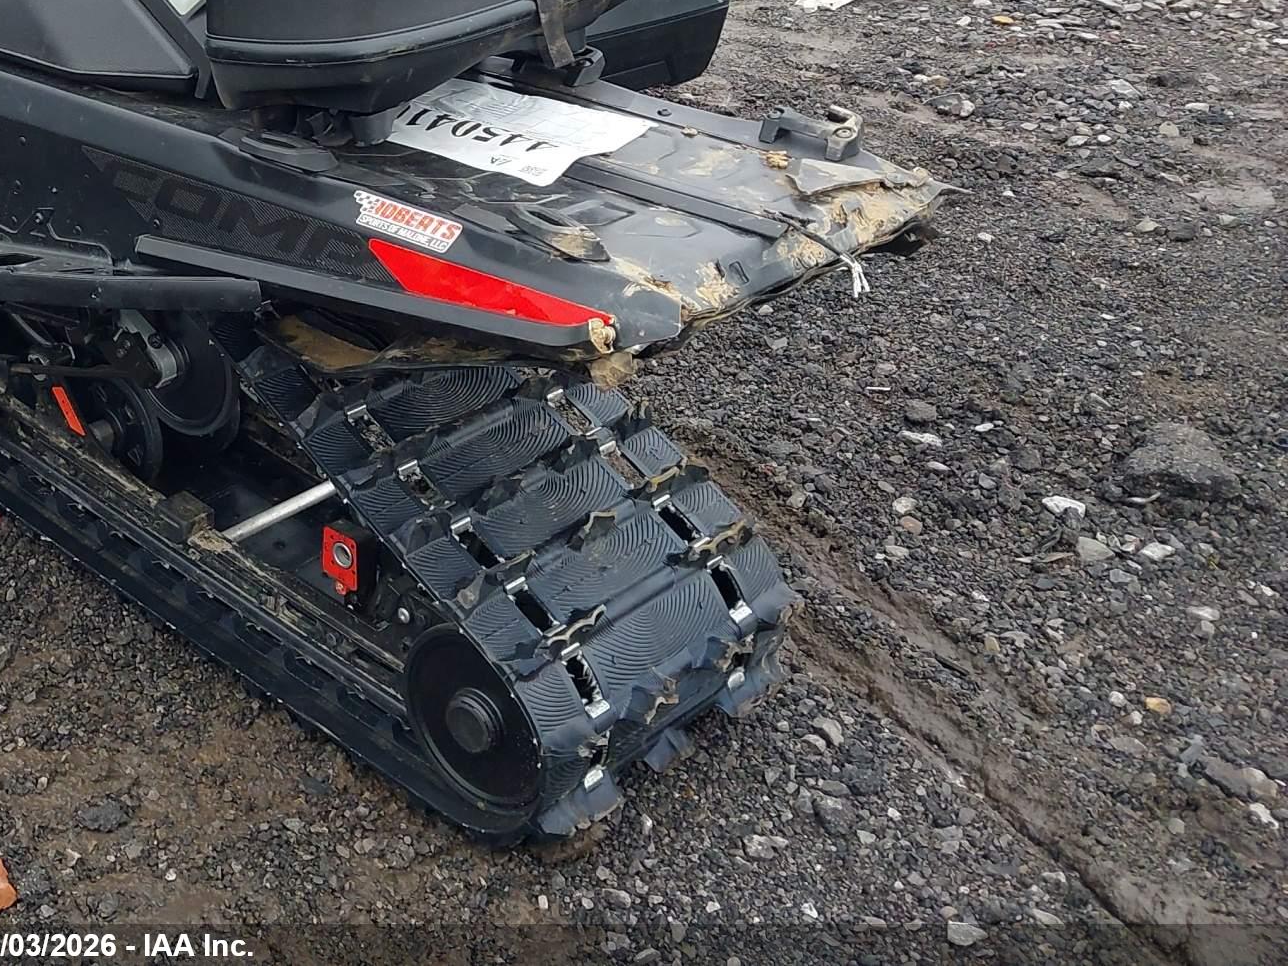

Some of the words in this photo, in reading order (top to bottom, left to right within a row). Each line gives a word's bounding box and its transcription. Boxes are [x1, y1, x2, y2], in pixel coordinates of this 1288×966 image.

[396, 104, 559, 153] 445041
[359, 215, 389, 231] SPORTS
[428, 237, 449, 251] LLC
